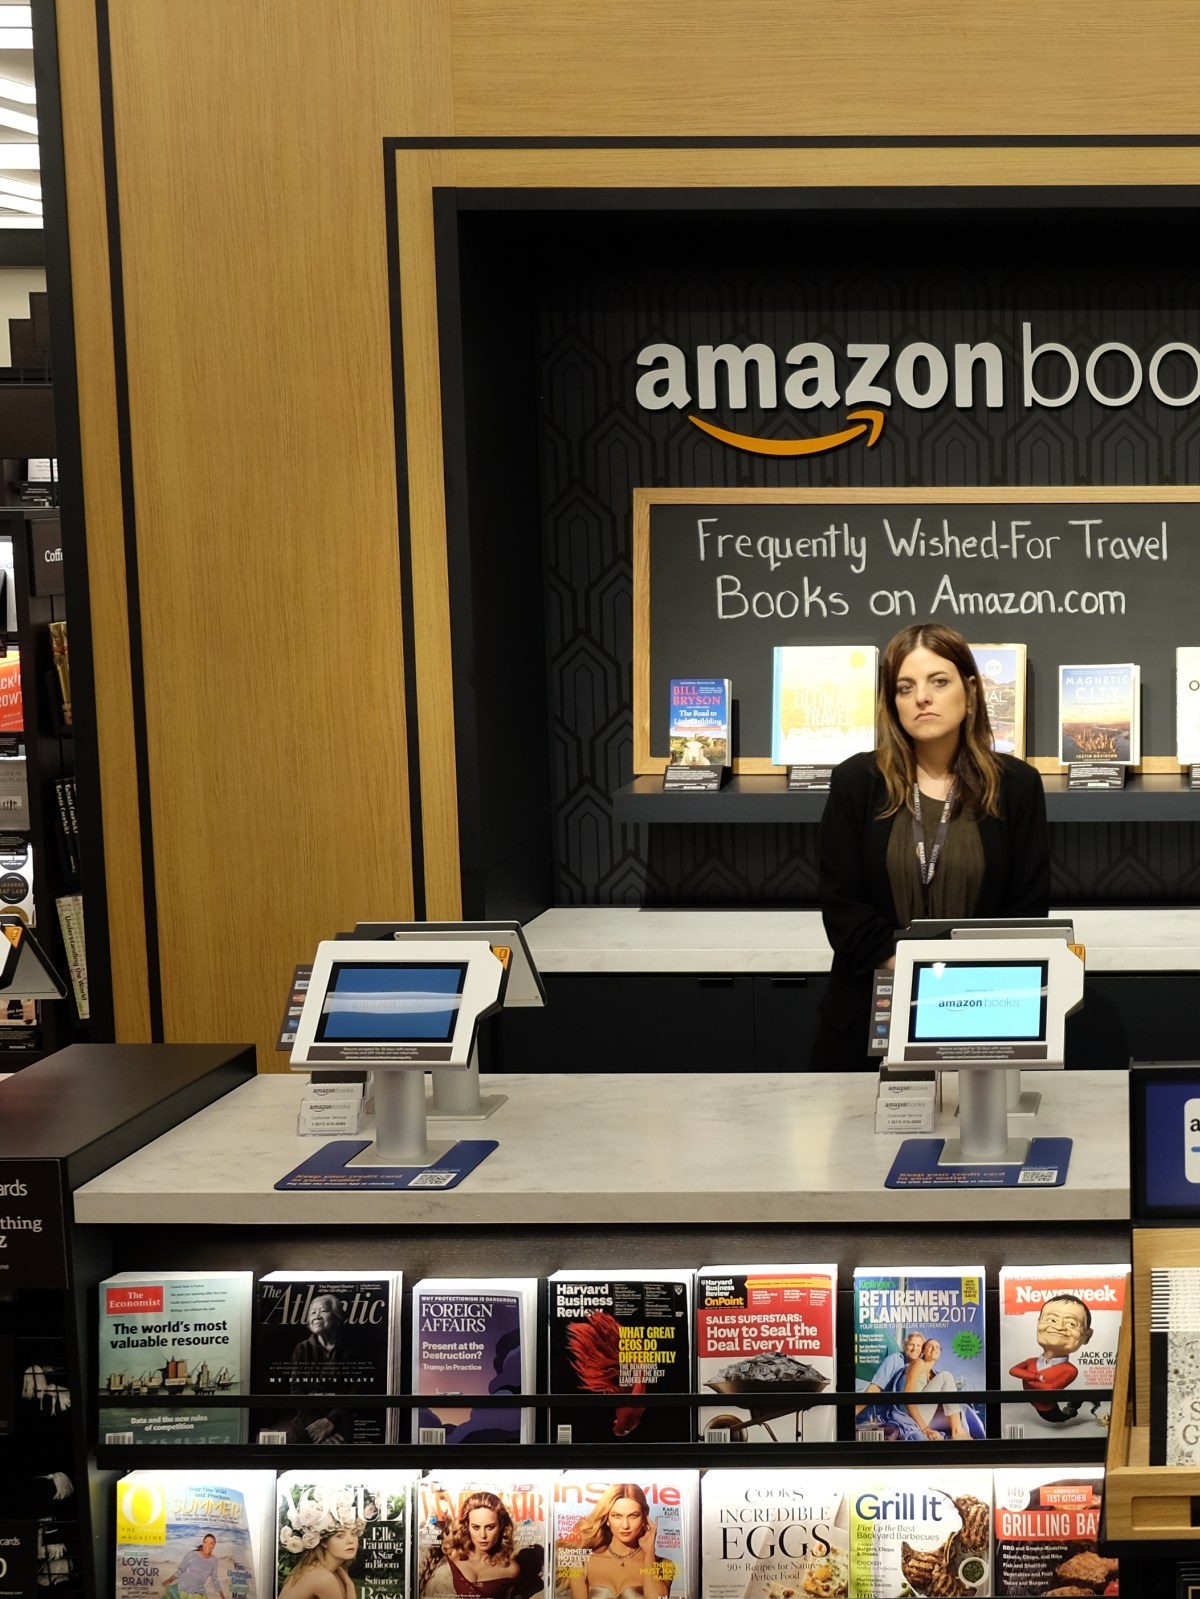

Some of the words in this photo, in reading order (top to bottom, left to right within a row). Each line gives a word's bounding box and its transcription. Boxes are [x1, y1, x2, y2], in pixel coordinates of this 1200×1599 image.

[635, 342, 1003, 410] amazon
[697, 518, 868, 572] Frequently
[884, 518, 1061, 559] Wished-For
[1068, 520, 1168, 562] Travel
[716, 575, 848, 620] Books
[869, 589, 916, 617] on
[930, 575, 1125, 617] Amazon.com
[1066, 676, 1129, 685] MAGNETIC
[673, 686, 698, 695] BILL
[1075, 687, 1120, 700] CITY
[673, 696, 721, 705] BRYSON
[938, 999, 983, 1008] amazon
[985, 998, 1019, 1008] books
[263, 1284, 282, 1298] The
[557, 1284, 609, 1294] Harvard
[127, 1291, 143, 1300] The
[557, 1295, 613, 1306] Business
[705, 1296, 744, 1306] OnPoint
[860, 1290, 959, 1306] RETIREMENT
[109, 1298, 161, 1309] Economist
[262, 1283, 385, 1325] Atltic
[421, 1304, 493, 1318] FOREIGN
[860, 1307, 939, 1323] PLANNING
[941, 1307, 976, 1322] 2017
[706, 1316, 736, 1324] SALES
[738, 1314, 802, 1323] SUPERSTARS:
[114, 1323, 138, 1335] The
[142, 1321, 190, 1335] world's
[193, 1320, 227, 1333] most
[421, 1318, 486, 1332] AFFAIRS
[707, 1326, 739, 1338] How
[742, 1326, 757, 1336] to
[761, 1323, 791, 1336] Seal
[794, 1323, 817, 1336] the
[619, 1327, 645, 1338] WHAT
[647, 1327, 675, 1339] GREAT
[110, 1336, 168, 1349] valuable
[171, 1334, 229, 1347] resource
[422, 1341, 456, 1351] Present
[457, 1342, 467, 1350] at
[469, 1342, 484, 1350] the
[619, 1339, 642, 1350] CEOS
[644, 1339, 657, 1350] DO
[707, 1338, 739, 1351] Deal
[743, 1340, 784, 1352] Every
[786, 1337, 820, 1349] Time
[422, 1350, 482, 1360] Destruction?
[619, 1351, 676, 1363] DIFFERENTLY
[423, 1364, 444, 1372] Trump
[131, 1416, 145, 1424] Data
[147, 1416, 160, 1424] and
[162, 1416, 173, 1424] the
[191, 1414, 208, 1422] rules
[153, 1422, 194, 1432] competition
[1047, 1494, 1060, 1502] TEST
[1062, 1494, 1086, 1502] KITCHEN
[856, 1493, 914, 1521] Grill
[922, 1497, 942, 1522] It
[720, 1507, 830, 1523] INCREDIBLE
[1002, 1513, 1070, 1536] GRILLING
[1077, 1513, 1100, 1535] BA
[372, 1527, 396, 1541] Elle
[857, 1532, 894, 1540] Backyard
[719, 1524, 831, 1559] EGGS
[122, 1557, 149, 1566] LOVE
[131, 1567, 159, 1576] YOUR
[122, 1577, 154, 1586] BRAIN
